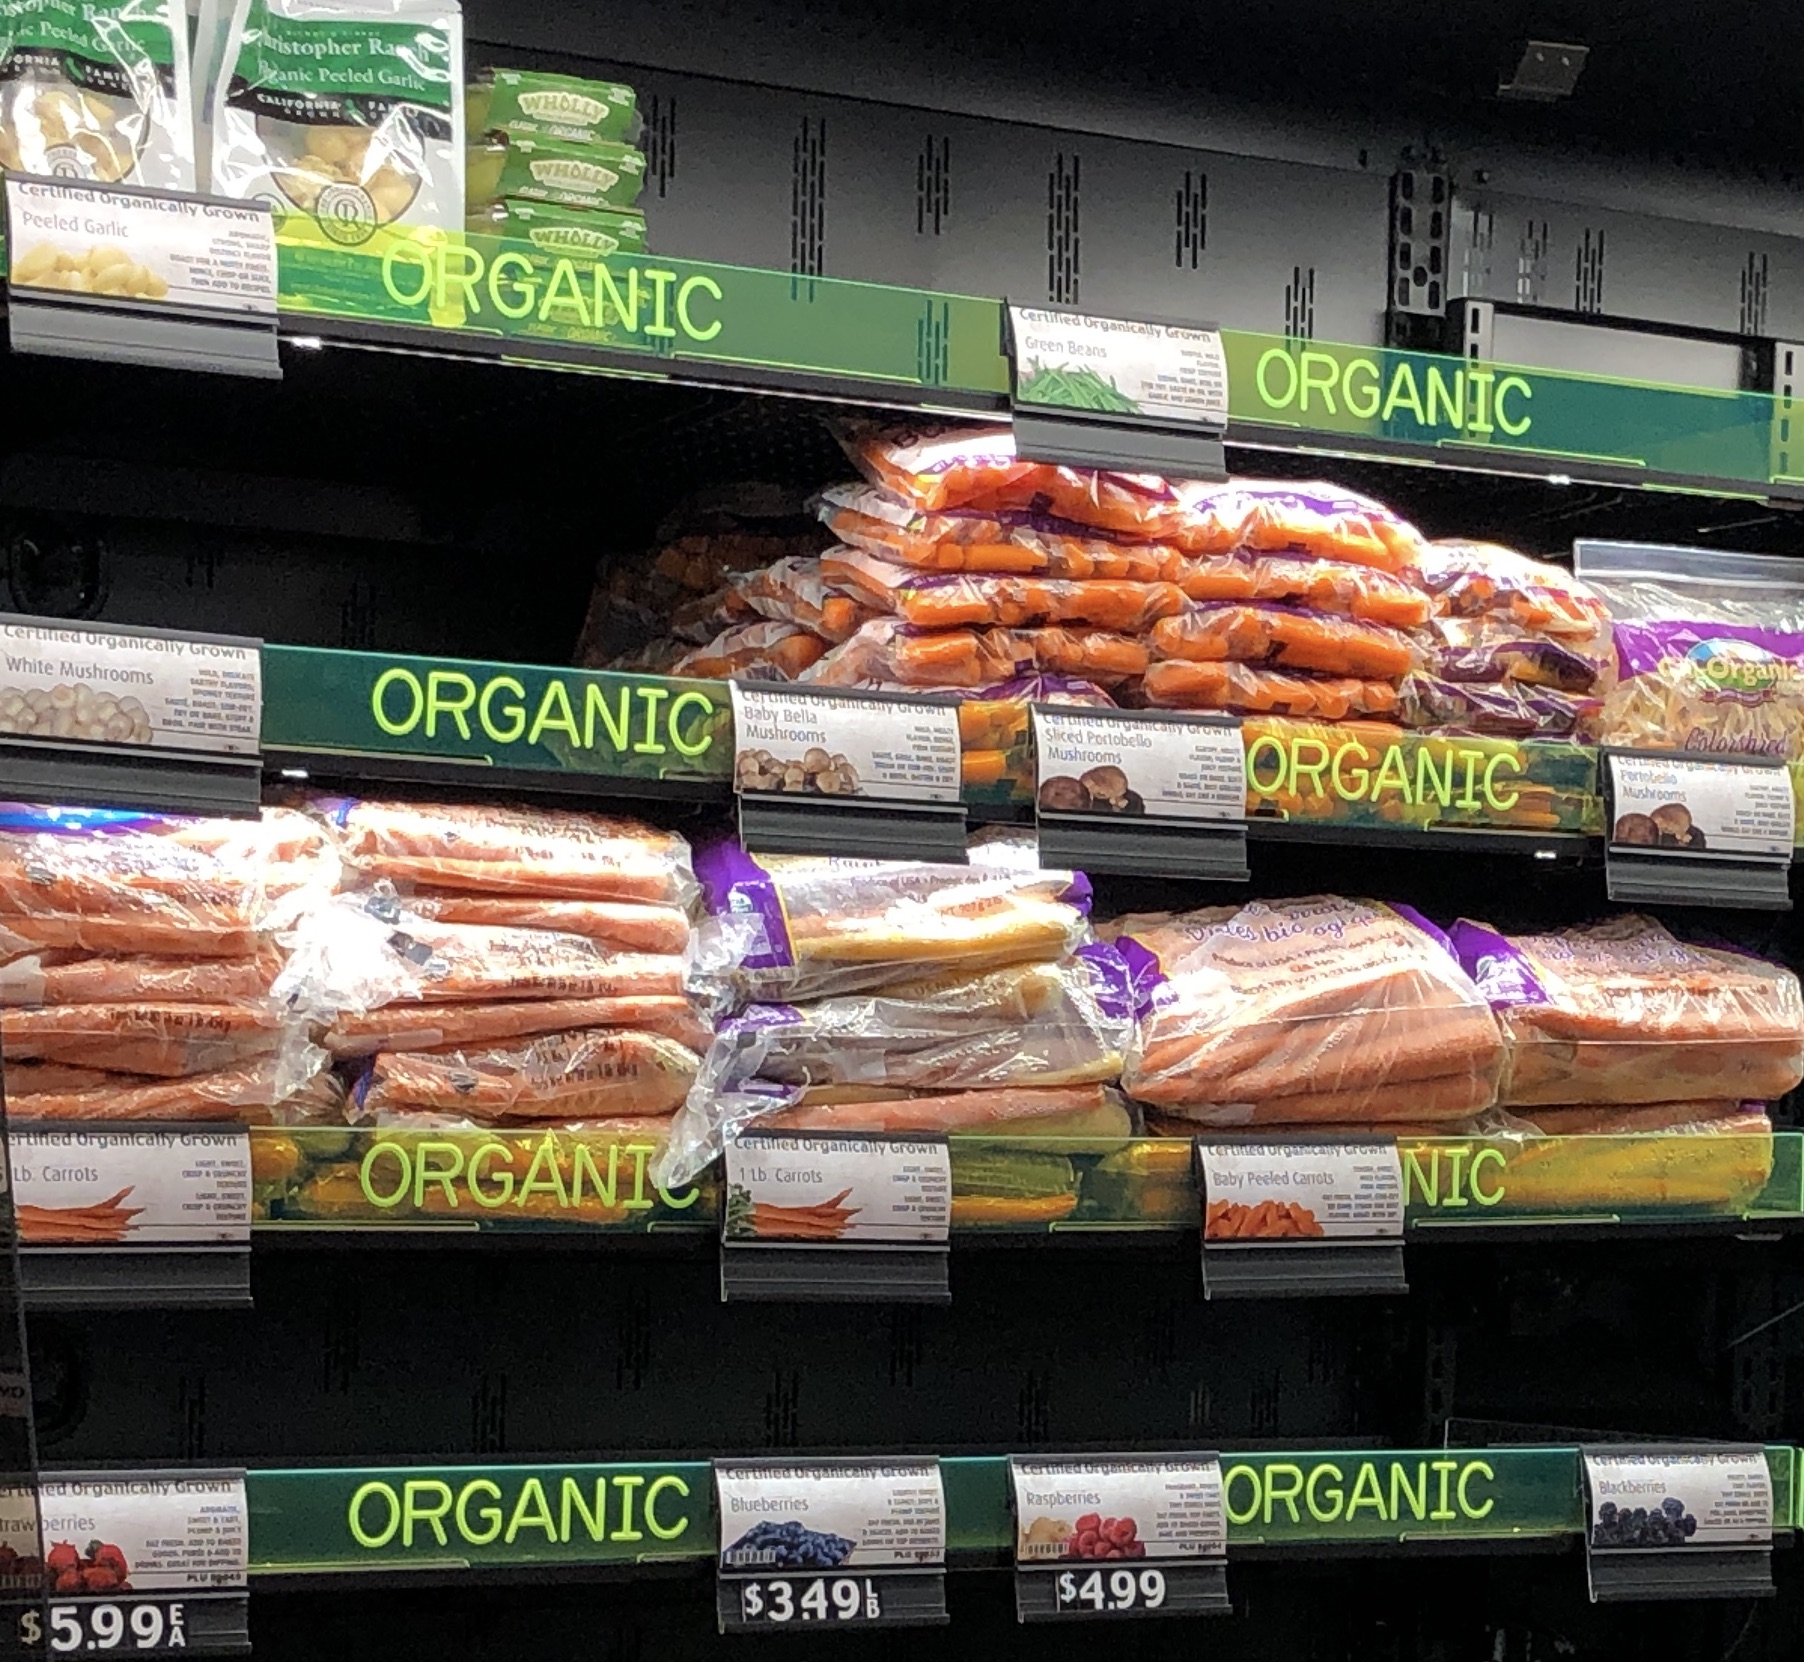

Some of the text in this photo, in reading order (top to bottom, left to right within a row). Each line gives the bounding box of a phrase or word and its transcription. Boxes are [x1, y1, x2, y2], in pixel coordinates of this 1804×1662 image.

[318, 66, 374, 83] Peeled
[203, 205, 260, 223] Grown
[23, 211, 129, 238] Peeled Garlic
[382, 240, 722, 340] ORGANIC
[1024, 335, 1107, 360] Green Beans
[1256, 348, 1533, 435] ORGANIC
[5, 655, 155, 685] White Mushrooms
[372, 668, 713, 756] ORGANIC
[744, 706, 818, 725] Baby Bella
[746, 725, 827, 743] Mushrooms
[1045, 728, 1153, 748] Sliced Portobello
[1048, 746, 1122, 765] Mushrooms
[1247, 735, 1521, 811] ORGANIC
[1622, 785, 1687, 802] Mushrooms
[8, 1132, 72, 1147] ertified
[889, 1142, 938, 1154] Grown
[42, 1165, 99, 1182] Carrots
[739, 1167, 745, 1182] 1
[775, 1168, 823, 1183] Carrots
[1213, 1170, 1335, 1188] Baby Peeled Carrots
[1223, 1461, 1495, 1525] ORGANIC
[1599, 1479, 1667, 1495] Blackberries
[731, 1497, 809, 1513] Blueberries
[1026, 1490, 1101, 1509] Raspberries
[349, 1476, 690, 1548] ORGANIC
[1059, 1569, 1167, 1611] $4.99
[745, 1577, 861, 1623] $3.49
[20, 1602, 165, 1652] $5.99
